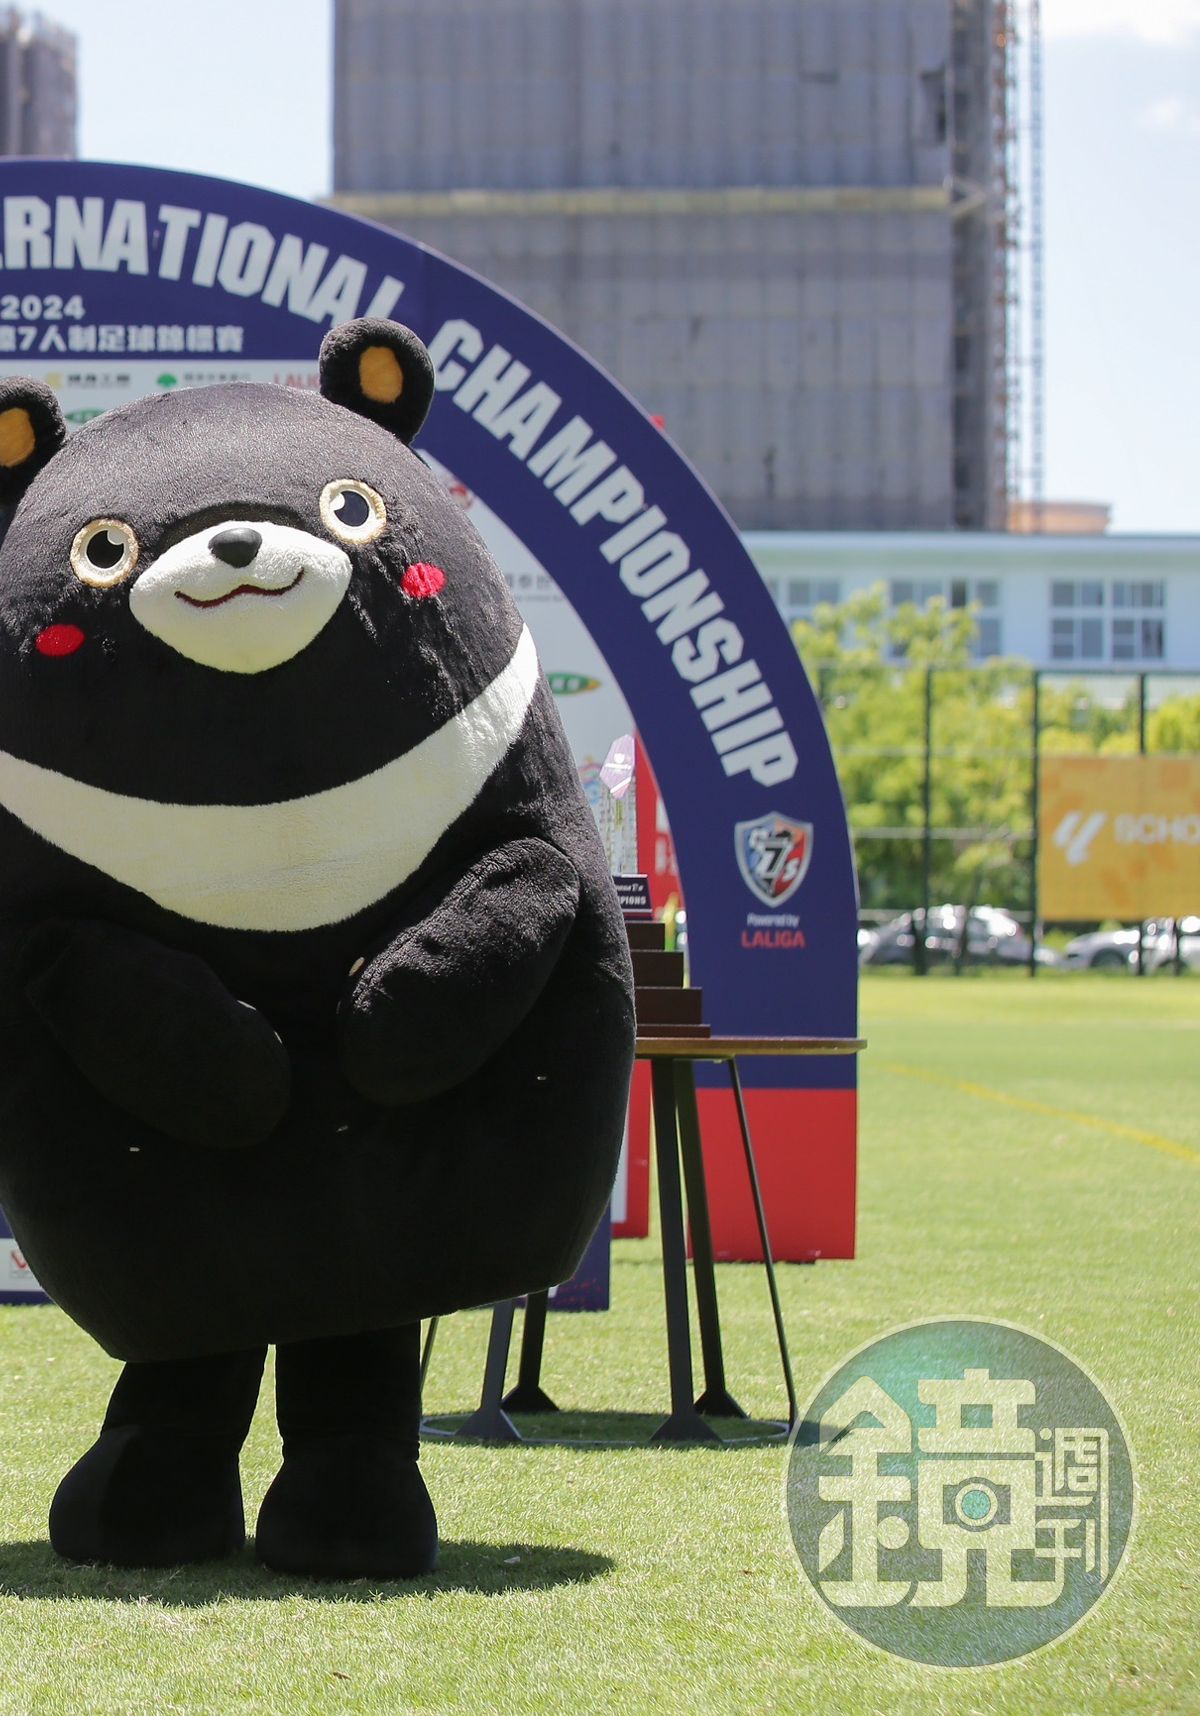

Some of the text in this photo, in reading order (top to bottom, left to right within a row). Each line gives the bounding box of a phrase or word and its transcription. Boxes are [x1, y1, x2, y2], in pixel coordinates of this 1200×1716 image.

[0, 295, 85, 320] 2024
[431, 319, 798, 787] CHAMPIONSHIP
[741, 930, 806, 949] LALIGA
